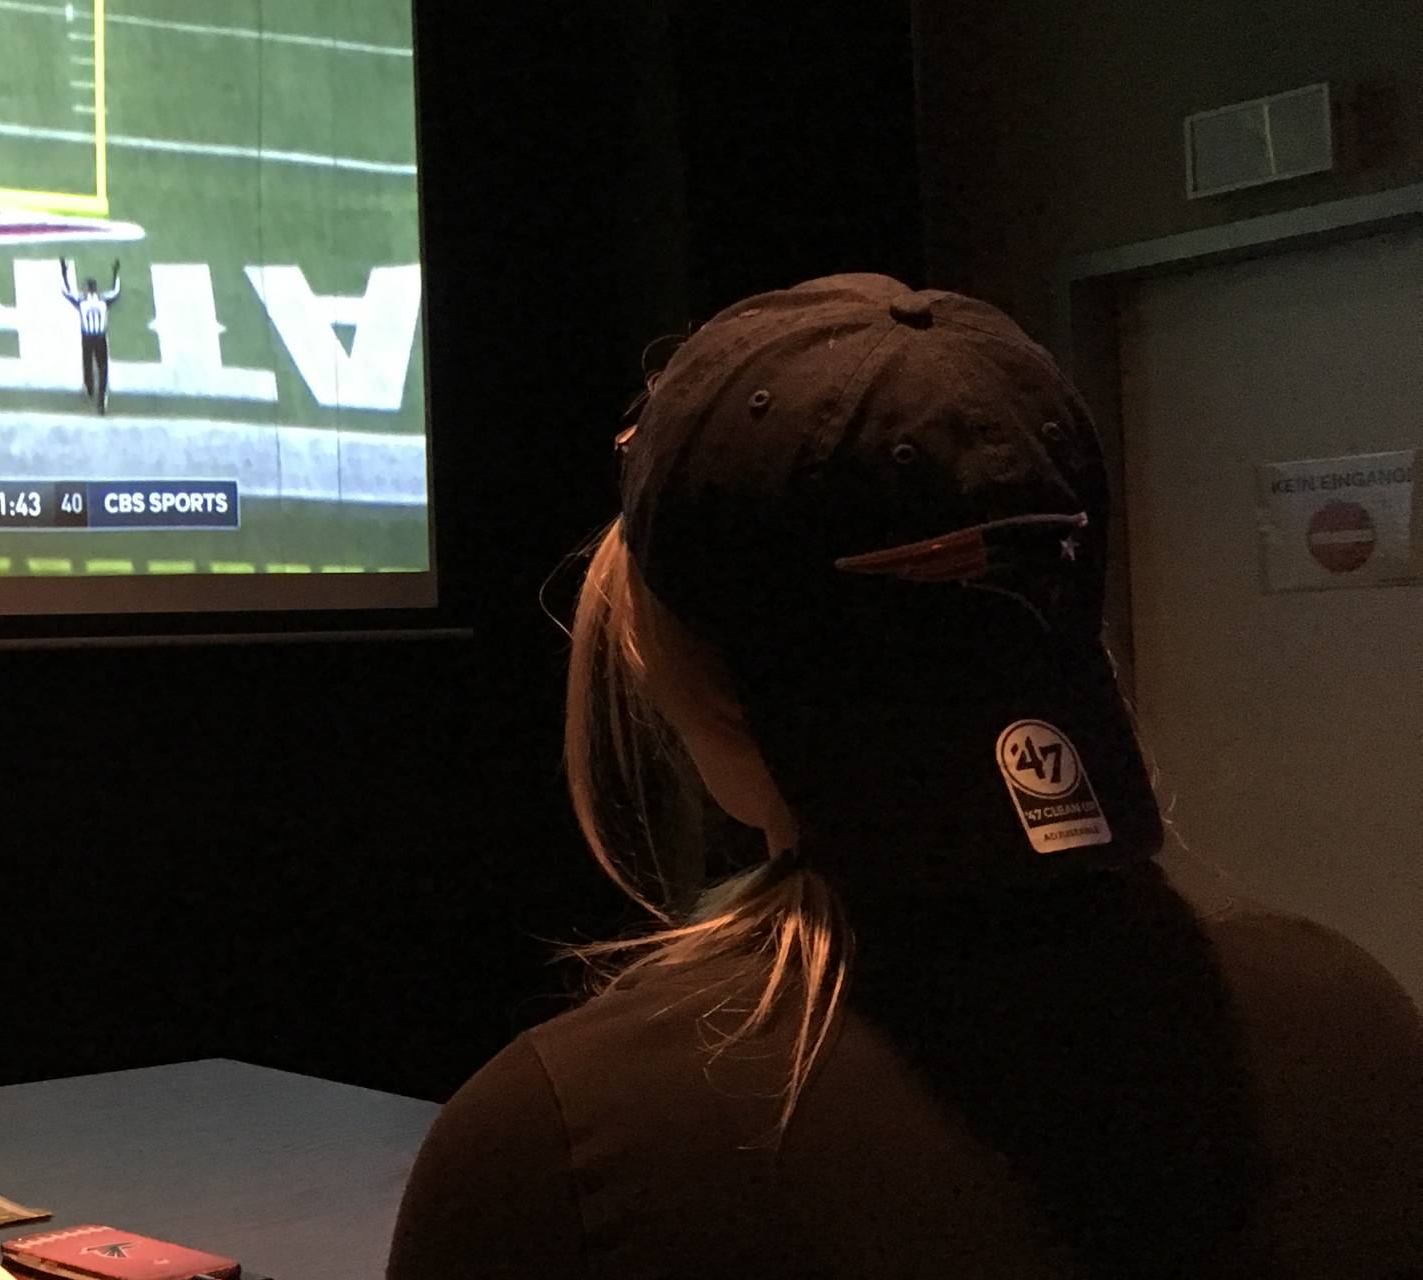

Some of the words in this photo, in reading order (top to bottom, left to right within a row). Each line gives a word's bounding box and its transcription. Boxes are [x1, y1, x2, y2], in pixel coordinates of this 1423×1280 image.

[1271, 478, 1315, 494] KEIN
[60, 492, 84, 515] 40
[103, 492, 146, 514] CBS
[149, 492, 229, 514] SPORTS
